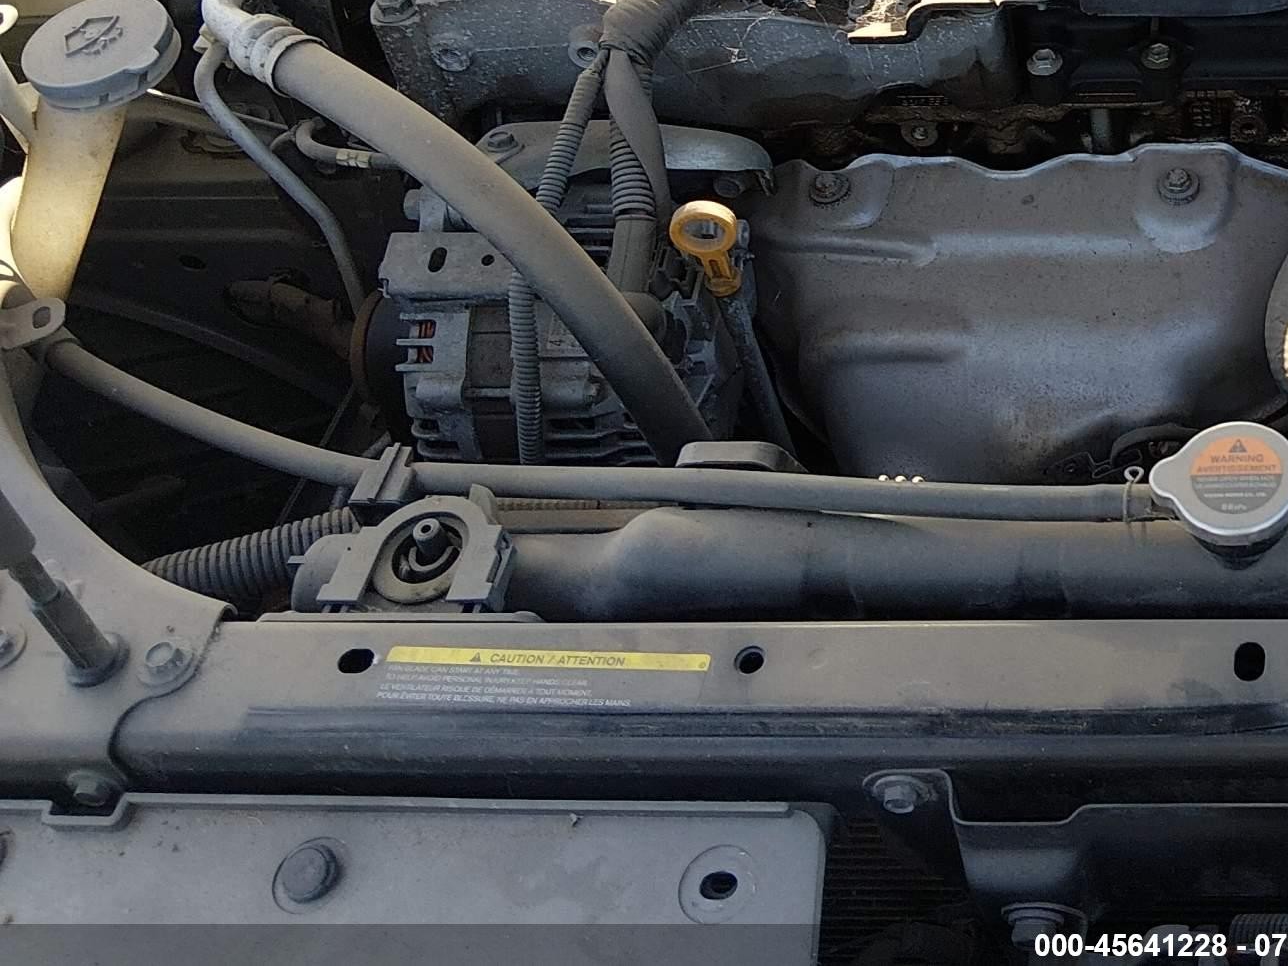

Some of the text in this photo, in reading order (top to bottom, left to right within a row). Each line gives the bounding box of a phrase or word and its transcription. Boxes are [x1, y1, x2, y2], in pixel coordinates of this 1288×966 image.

[1210, 454, 1264, 463] WARNING
[1197, 465, 1276, 473] AVERTISSEMENT
[490, 653, 545, 664] CAUTION
[556, 655, 626, 666] ATTENTION
